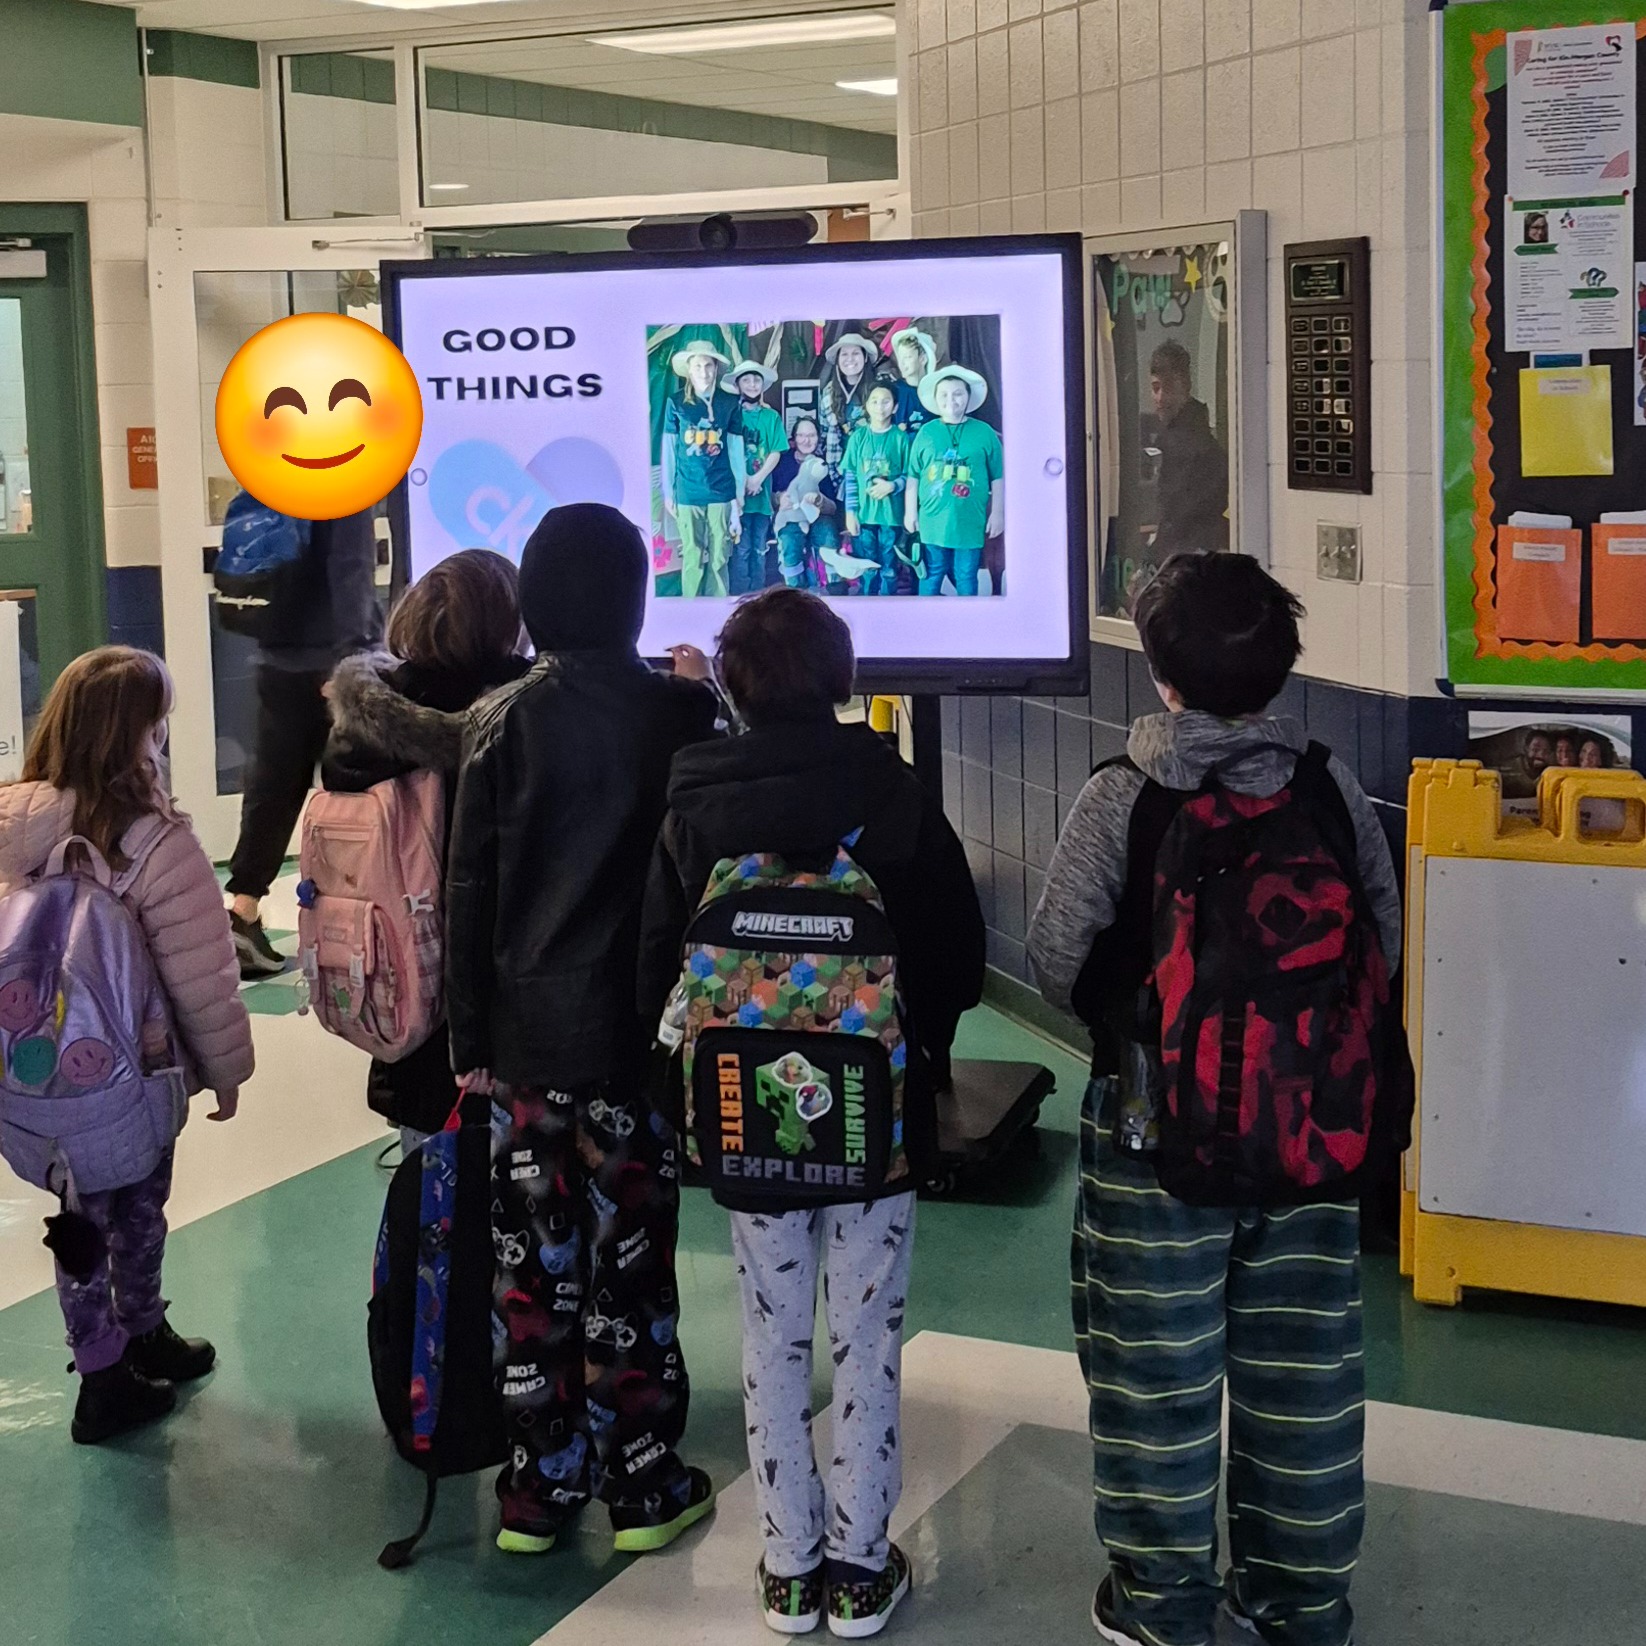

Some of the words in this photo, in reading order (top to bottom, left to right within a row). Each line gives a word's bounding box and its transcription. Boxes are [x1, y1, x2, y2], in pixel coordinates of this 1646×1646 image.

[442, 326, 576, 353] GOOD
[427, 373, 603, 401] THINGS
[731, 911, 854, 942] MINECRAFT
[717, 1053, 745, 1152] CREATE
[843, 1064, 866, 1164] SURVIVE
[722, 1154, 866, 1187] EXPLORE
